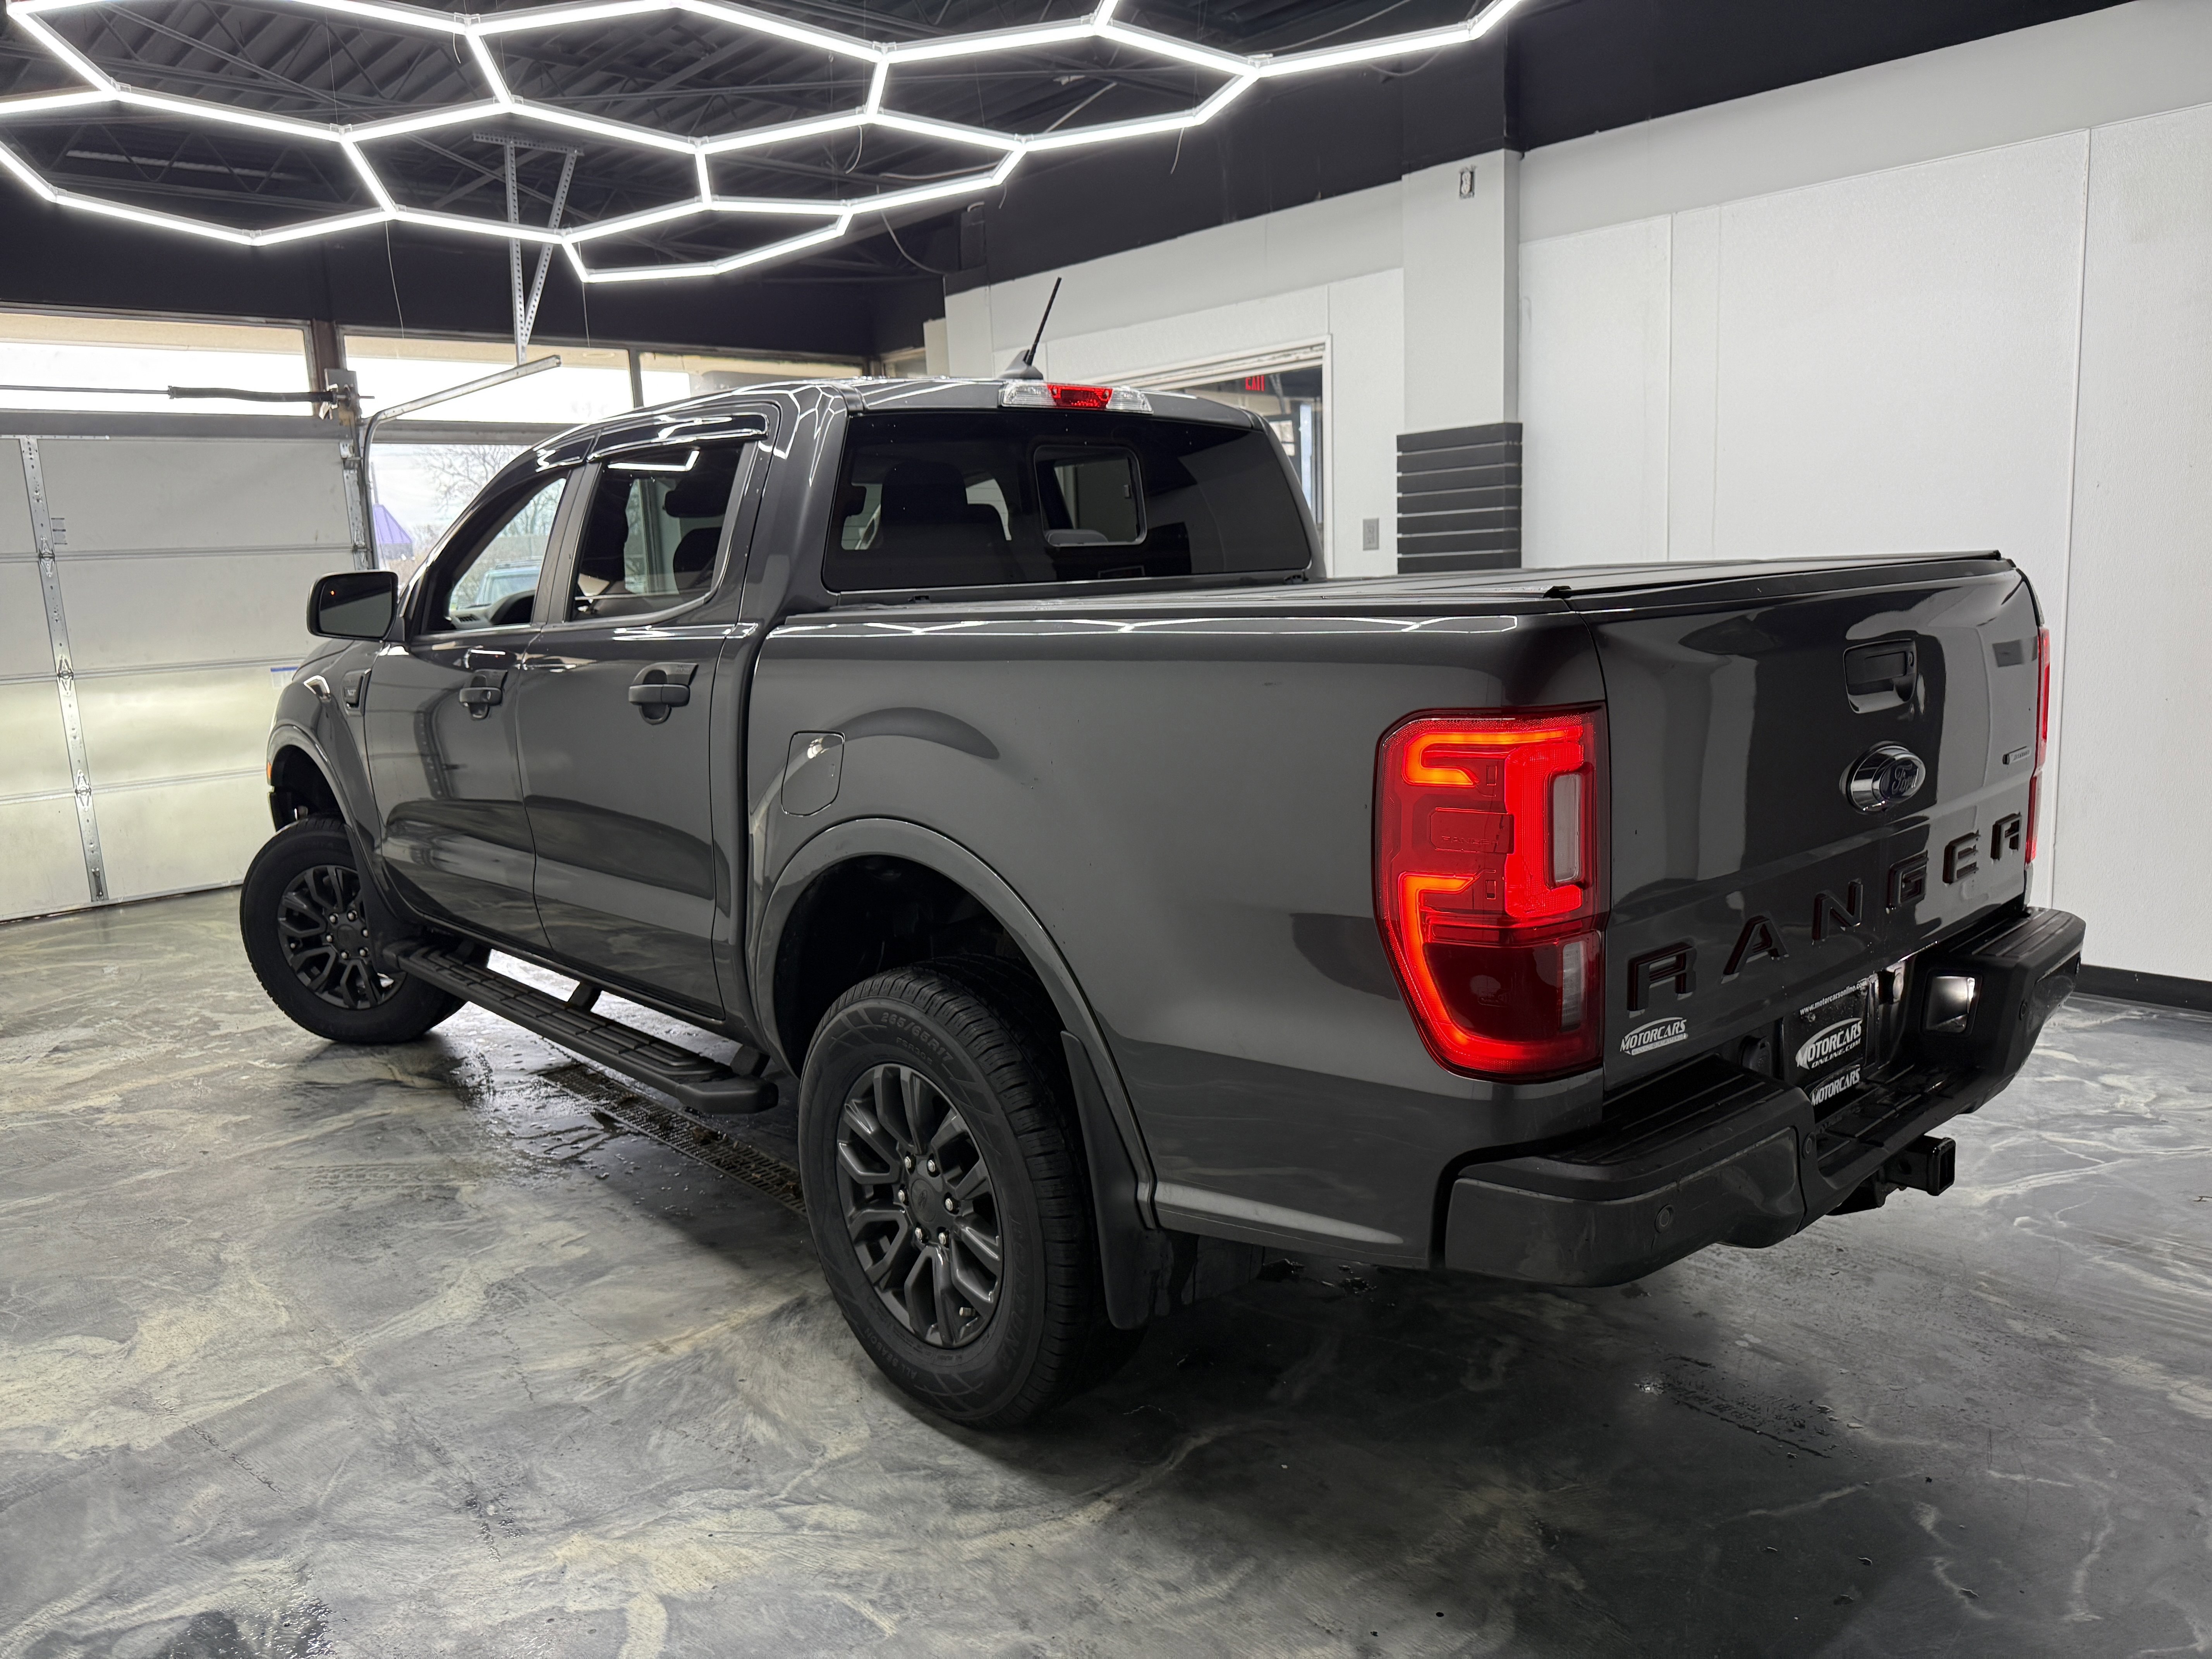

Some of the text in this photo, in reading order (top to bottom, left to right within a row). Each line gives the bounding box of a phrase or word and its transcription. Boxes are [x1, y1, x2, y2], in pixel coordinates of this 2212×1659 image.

[1627, 812, 2022, 1012] RANGER
[1800, 980, 1868, 1015] www.motorcarsonline.com
[881, 1012, 954, 1062] 265/65R17
[1620, 1019, 1687, 1052] MOTORCARS
[1797, 1020, 1863, 1067] MOTORCARS
[1811, 1037, 1861, 1069] ONLINE.COM
[1811, 1067, 1861, 1106] MOTORCARS
